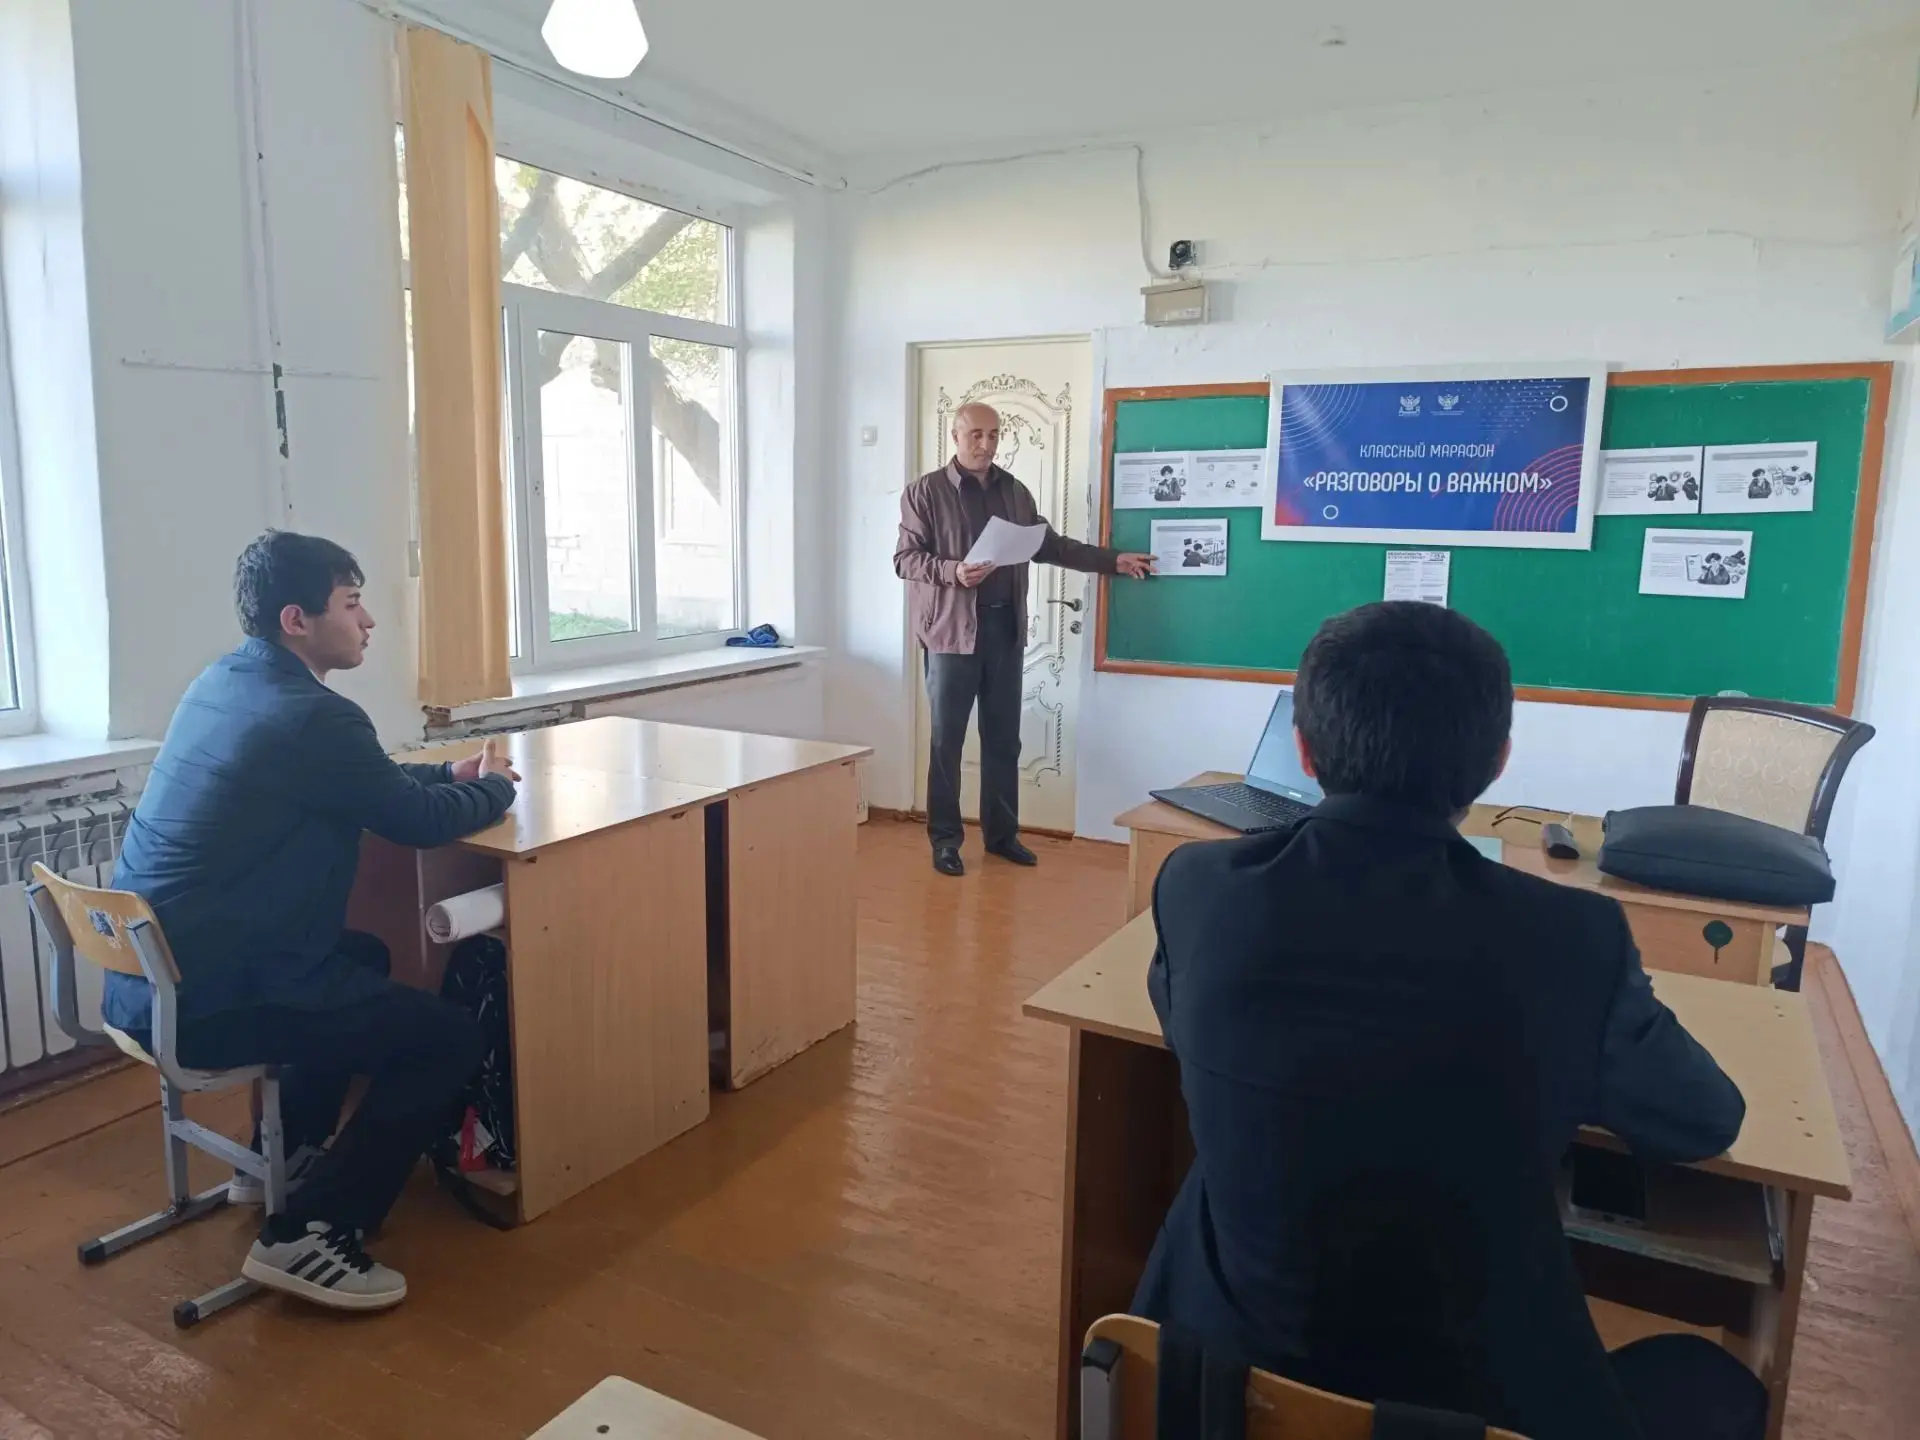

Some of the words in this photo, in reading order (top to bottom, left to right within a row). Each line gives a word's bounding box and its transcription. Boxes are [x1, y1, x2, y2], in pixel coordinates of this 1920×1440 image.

[1360, 442, 1425, 458] КЛАССНЫЙ
[1430, 444, 1495, 458] МАРАФОН
[1303, 471, 1422, 493] «РАЗГОВОРЫ
[1428, 472, 1441, 493] О
[1447, 472, 1553, 494] ВАЖНОМ»
